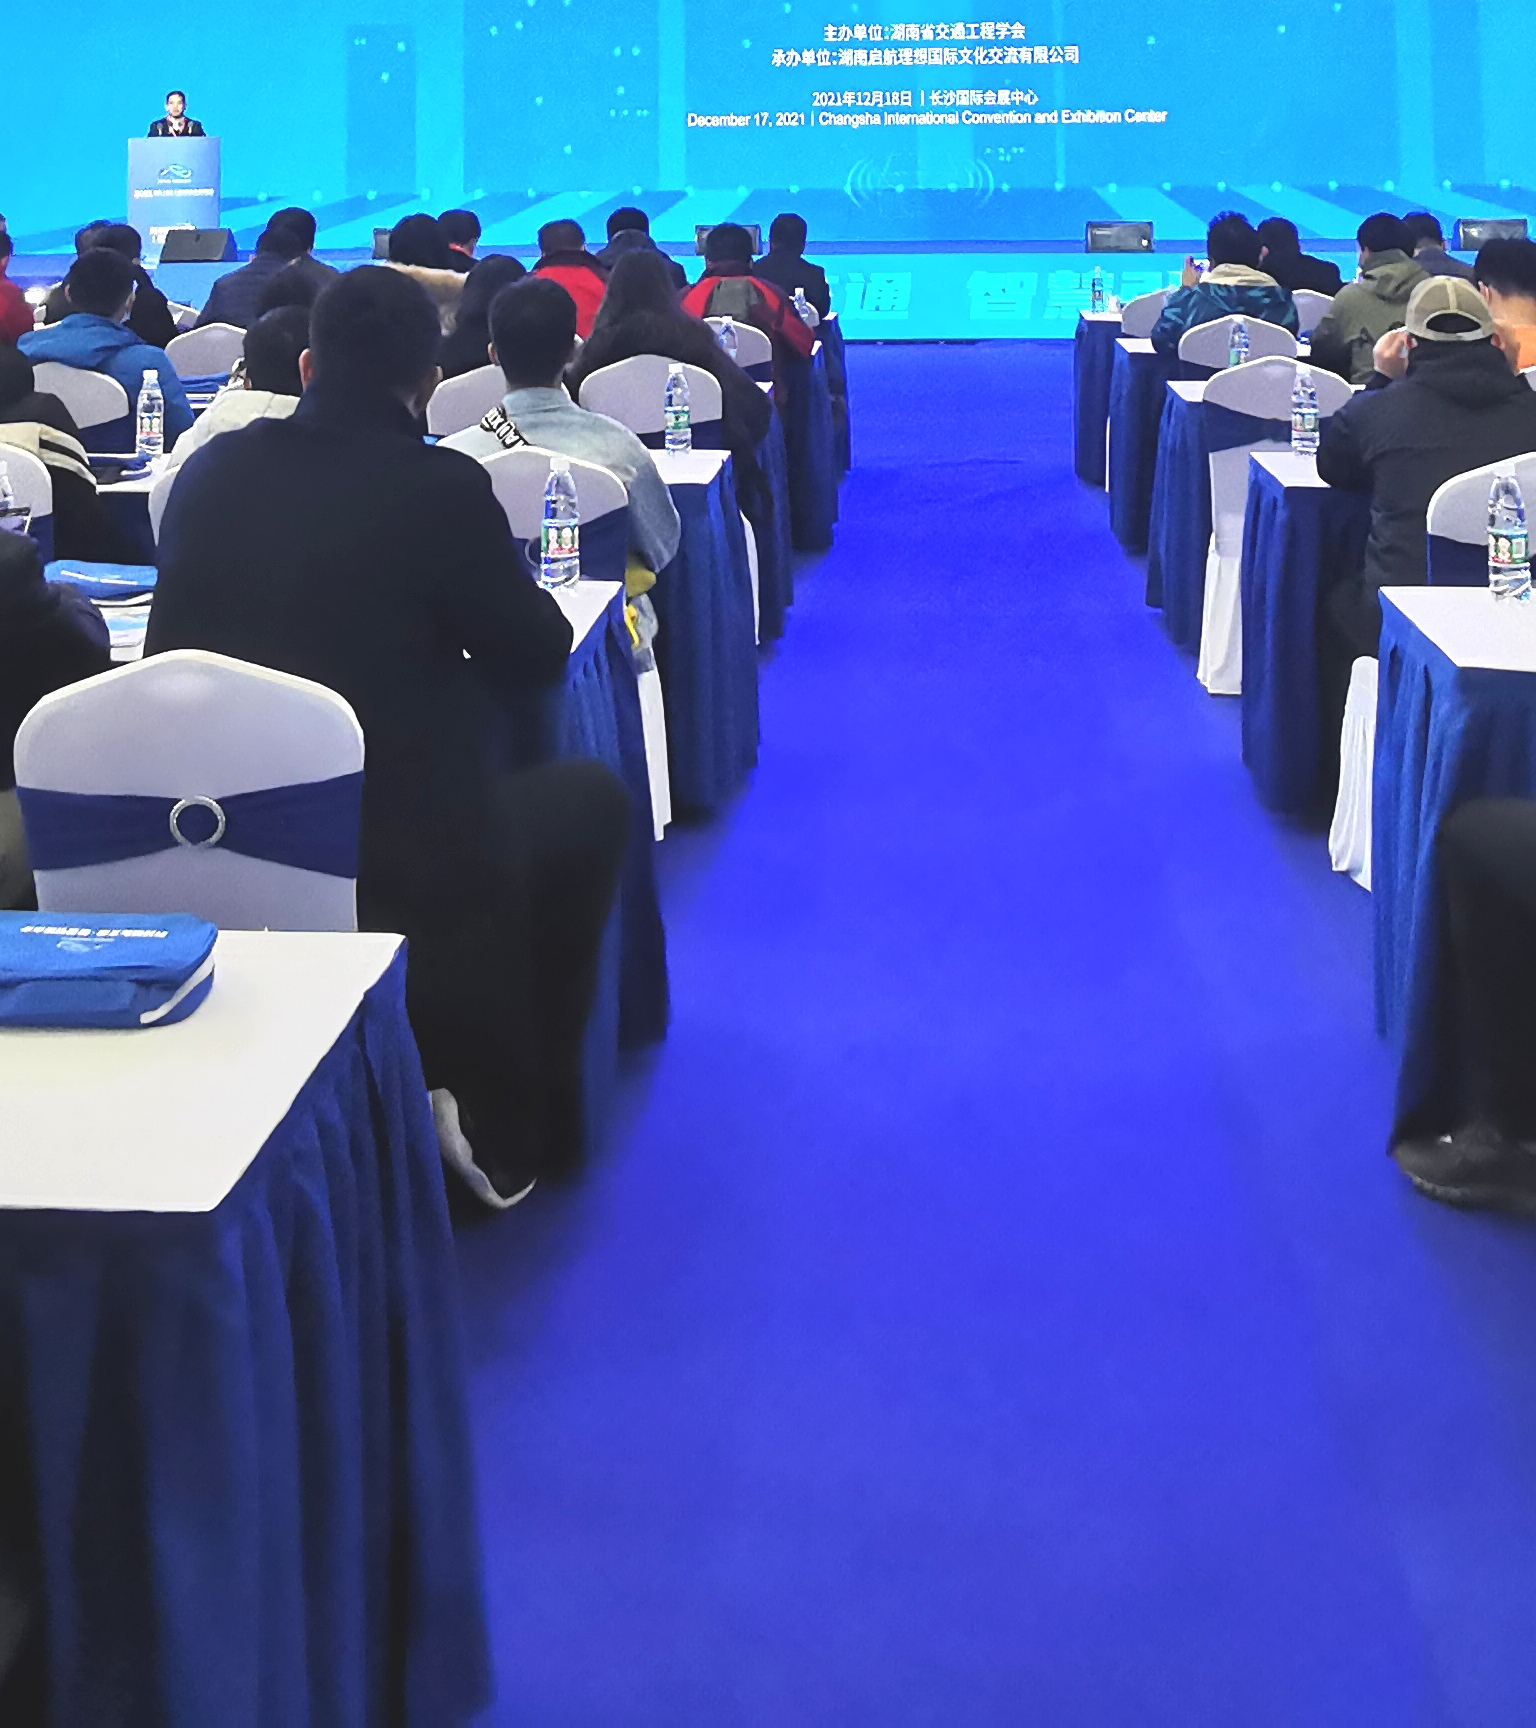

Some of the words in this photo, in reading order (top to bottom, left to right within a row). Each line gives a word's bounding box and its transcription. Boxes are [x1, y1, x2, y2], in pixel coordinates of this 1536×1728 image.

[929, 88, 1040, 107] 长沙国际会展中心
[687, 111, 751, 127] December
[775, 111, 805, 127] 2021
[818, 111, 882, 129] Changsha
[884, 109, 960, 126] International
[961, 109, 1032, 125] Convention
[1034, 110, 1059, 124] and
[1061, 109, 1123, 124] Exhibition
[1123, 108, 1169, 124] Center
